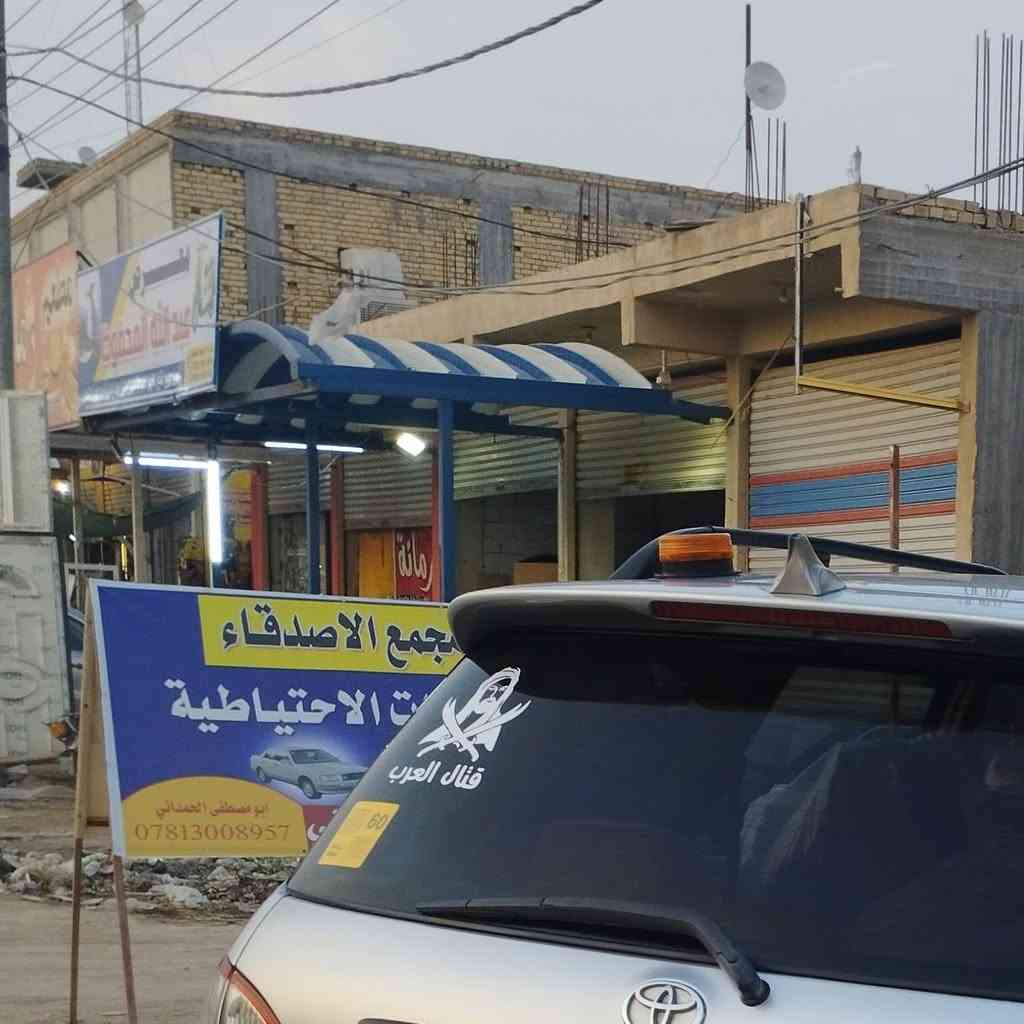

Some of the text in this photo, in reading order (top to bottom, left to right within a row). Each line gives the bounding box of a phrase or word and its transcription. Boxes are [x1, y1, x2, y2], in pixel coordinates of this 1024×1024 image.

[222, 602, 377, 650] الاصدقاء
[164, 678, 380, 736] الاحتياطية
[388, 760, 442, 785] العرب
[135, 823, 290, 841] 07813008957
